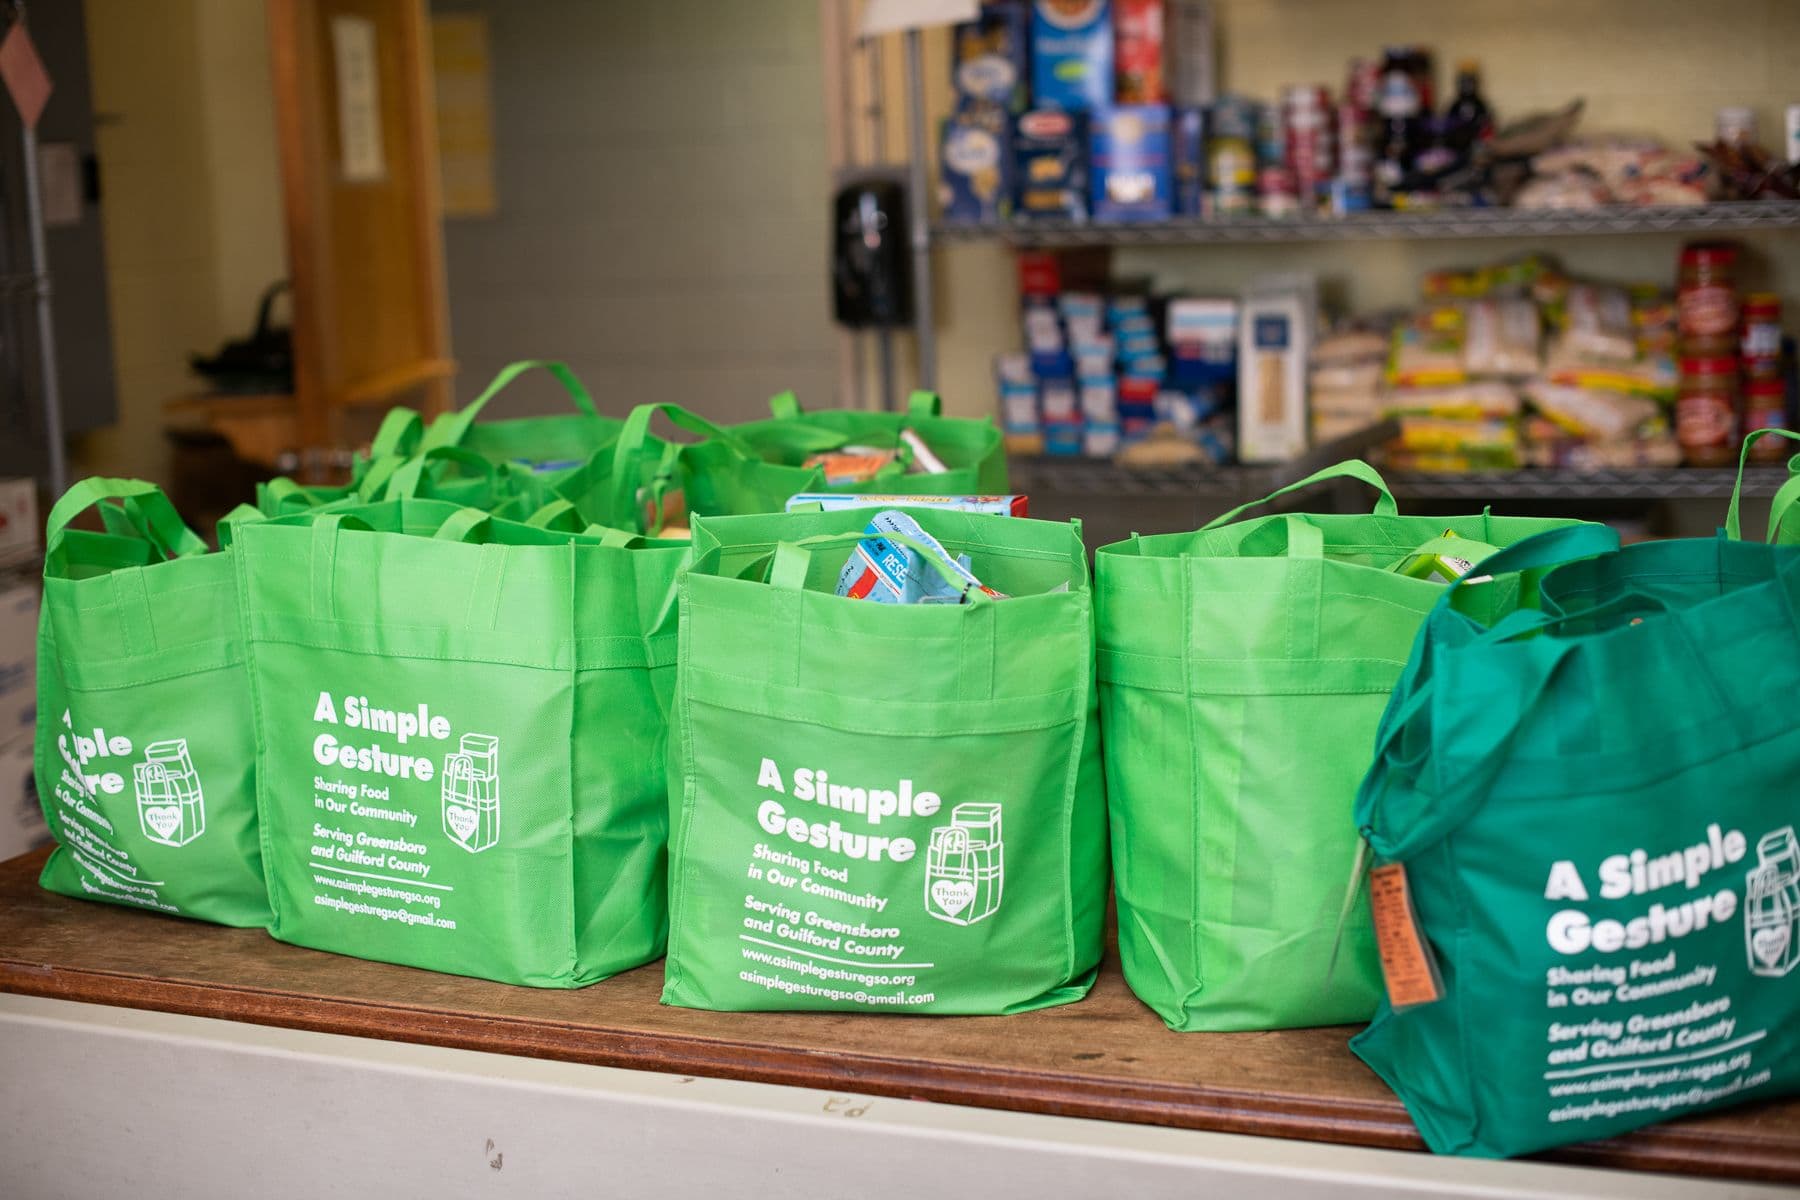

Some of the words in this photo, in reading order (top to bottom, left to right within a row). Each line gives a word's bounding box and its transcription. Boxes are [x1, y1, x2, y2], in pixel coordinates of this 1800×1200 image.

[313, 691, 338, 724] A
[344, 696, 451, 744] Simple
[313, 734, 434, 781] Gesture
[314, 776, 357, 799] Sharing
[360, 784, 389, 800] Food
[757, 757, 785, 794] A
[793, 767, 941, 824] Simple
[149, 811, 177, 821] Thank
[314, 794, 324, 809] in
[326, 798, 347, 813] Our
[349, 802, 417, 827] Community
[449, 811, 473, 824] Thank
[313, 823, 354, 846] Serving
[356, 832, 427, 855] Greensboro
[757, 800, 916, 862] Gesture
[310, 845, 333, 859] and
[336, 848, 385, 868] Guilford
[387, 857, 431, 878] County
[752, 843, 810, 874] Sharing
[813, 860, 848, 883] Food
[1543, 860, 1589, 901] A
[1598, 822, 1747, 899] Simple
[313, 874, 441, 909] www.asimplegesturegso.org
[747, 863, 762, 880] in
[766, 868, 798, 888] Our
[801, 877, 888, 913] Community
[935, 887, 969, 897] Thank
[942, 898, 962, 906] You
[314, 894, 456, 930] asimplegesturegso@gmail.com
[744, 895, 801, 924] Serving
[804, 911, 900, 938] Greensboro
[1546, 889, 1738, 955] Gesture
[743, 915, 773, 934] and
[776, 924, 841, 951] Guilford
[844, 940, 904, 960] County
[739, 969, 935, 1005] asimplegesturegso@gmail.com
[742, 947, 915, 987] www.asimplegesturegso.org
[1547, 964, 1627, 987] Sharing
[1629, 949, 1676, 979] Food
[1547, 988, 1568, 1008] in
[1571, 987, 1613, 1006] Our
[1615, 964, 1717, 1002] Community
[1548, 1018, 1624, 1042] Serving
[1627, 995, 1731, 1034] Greensboro
[1547, 1040, 1589, 1064] and
[1590, 1029, 1674, 1058] Guilford
[1676, 1016, 1736, 1048] County
